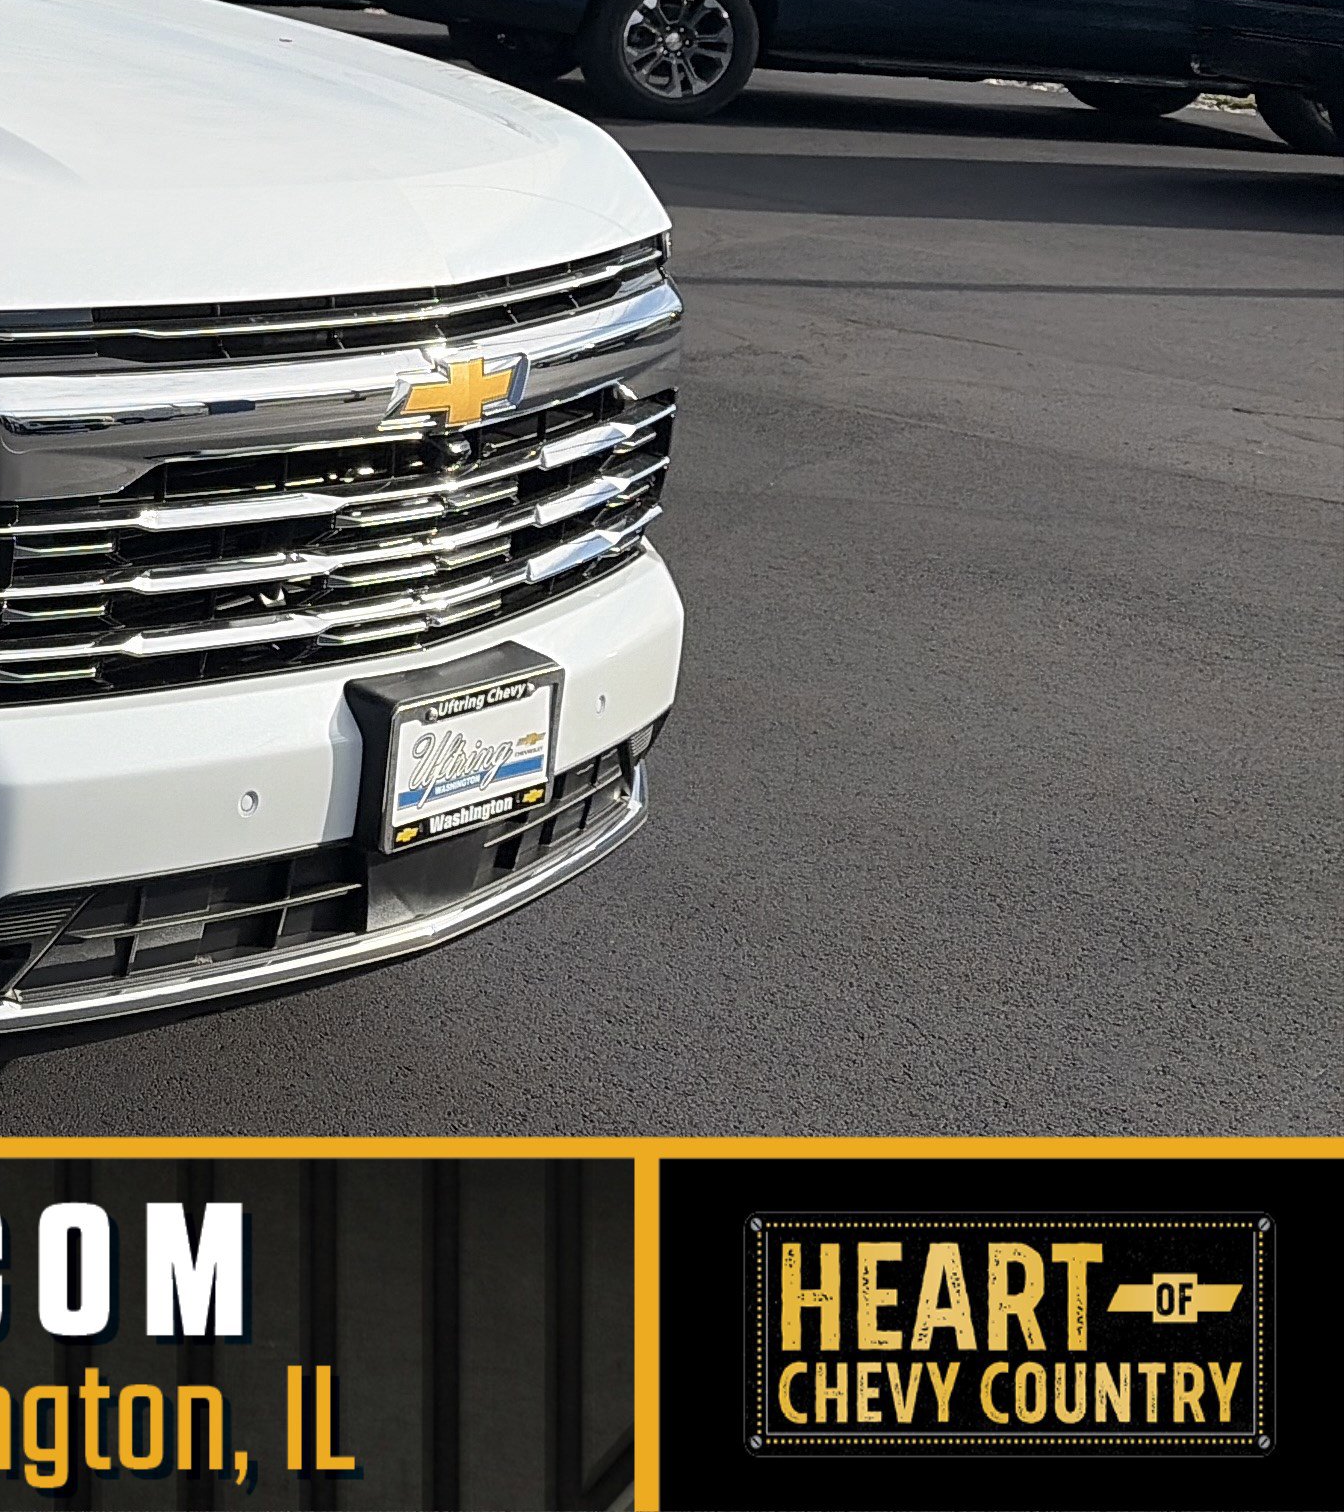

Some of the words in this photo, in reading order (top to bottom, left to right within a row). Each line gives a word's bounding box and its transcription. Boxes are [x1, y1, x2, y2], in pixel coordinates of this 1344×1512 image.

[438, 692, 485, 717] Uftring
[487, 683, 526, 703] Chevy
[410, 731, 513, 809] Uftring
[434, 773, 481, 796] WASHINGTON
[429, 797, 513, 834] Washington
